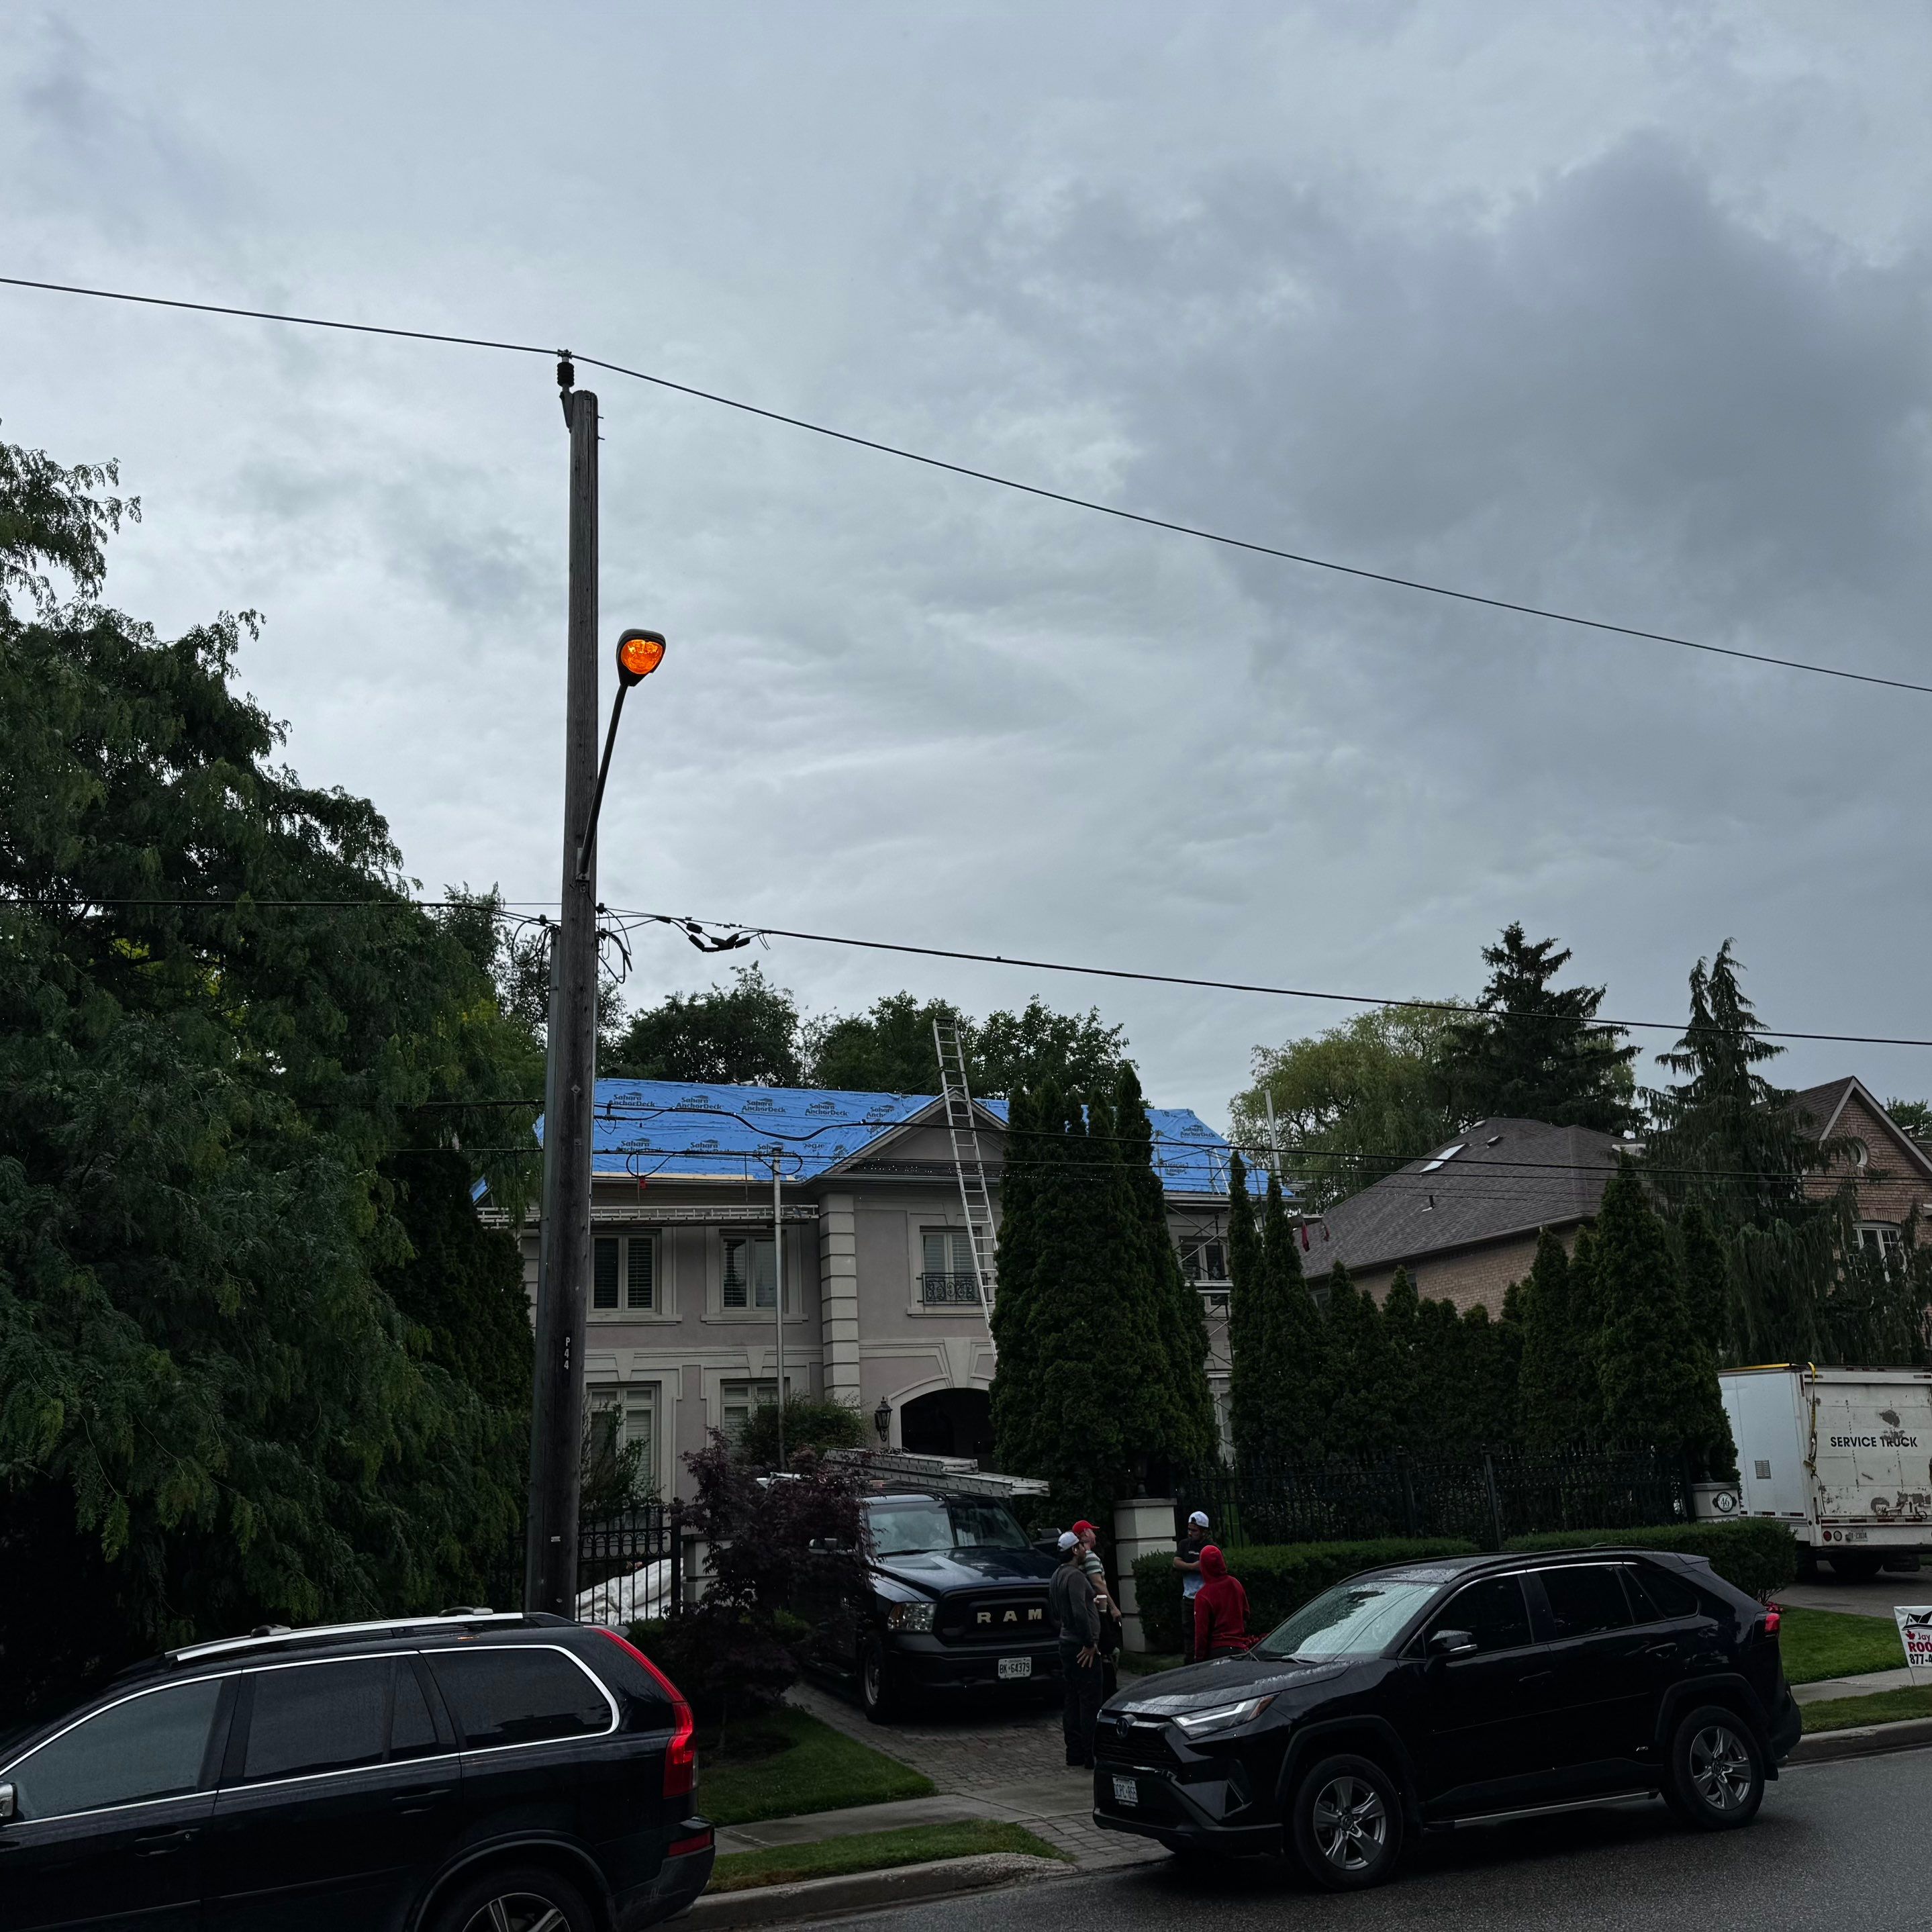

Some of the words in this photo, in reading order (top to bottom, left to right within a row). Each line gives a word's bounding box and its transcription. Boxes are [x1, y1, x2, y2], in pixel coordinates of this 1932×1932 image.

[1830, 1437, 1877, 1447] SERVICE
[1880, 1437, 1918, 1447] TRUCK
[1721, 1497, 1730, 1507] 46
[977, 1608, 1042, 1623] RAM
[1918, 1632, 1931, 1642] Jay
[1908, 1641, 1932, 1653] ROO
